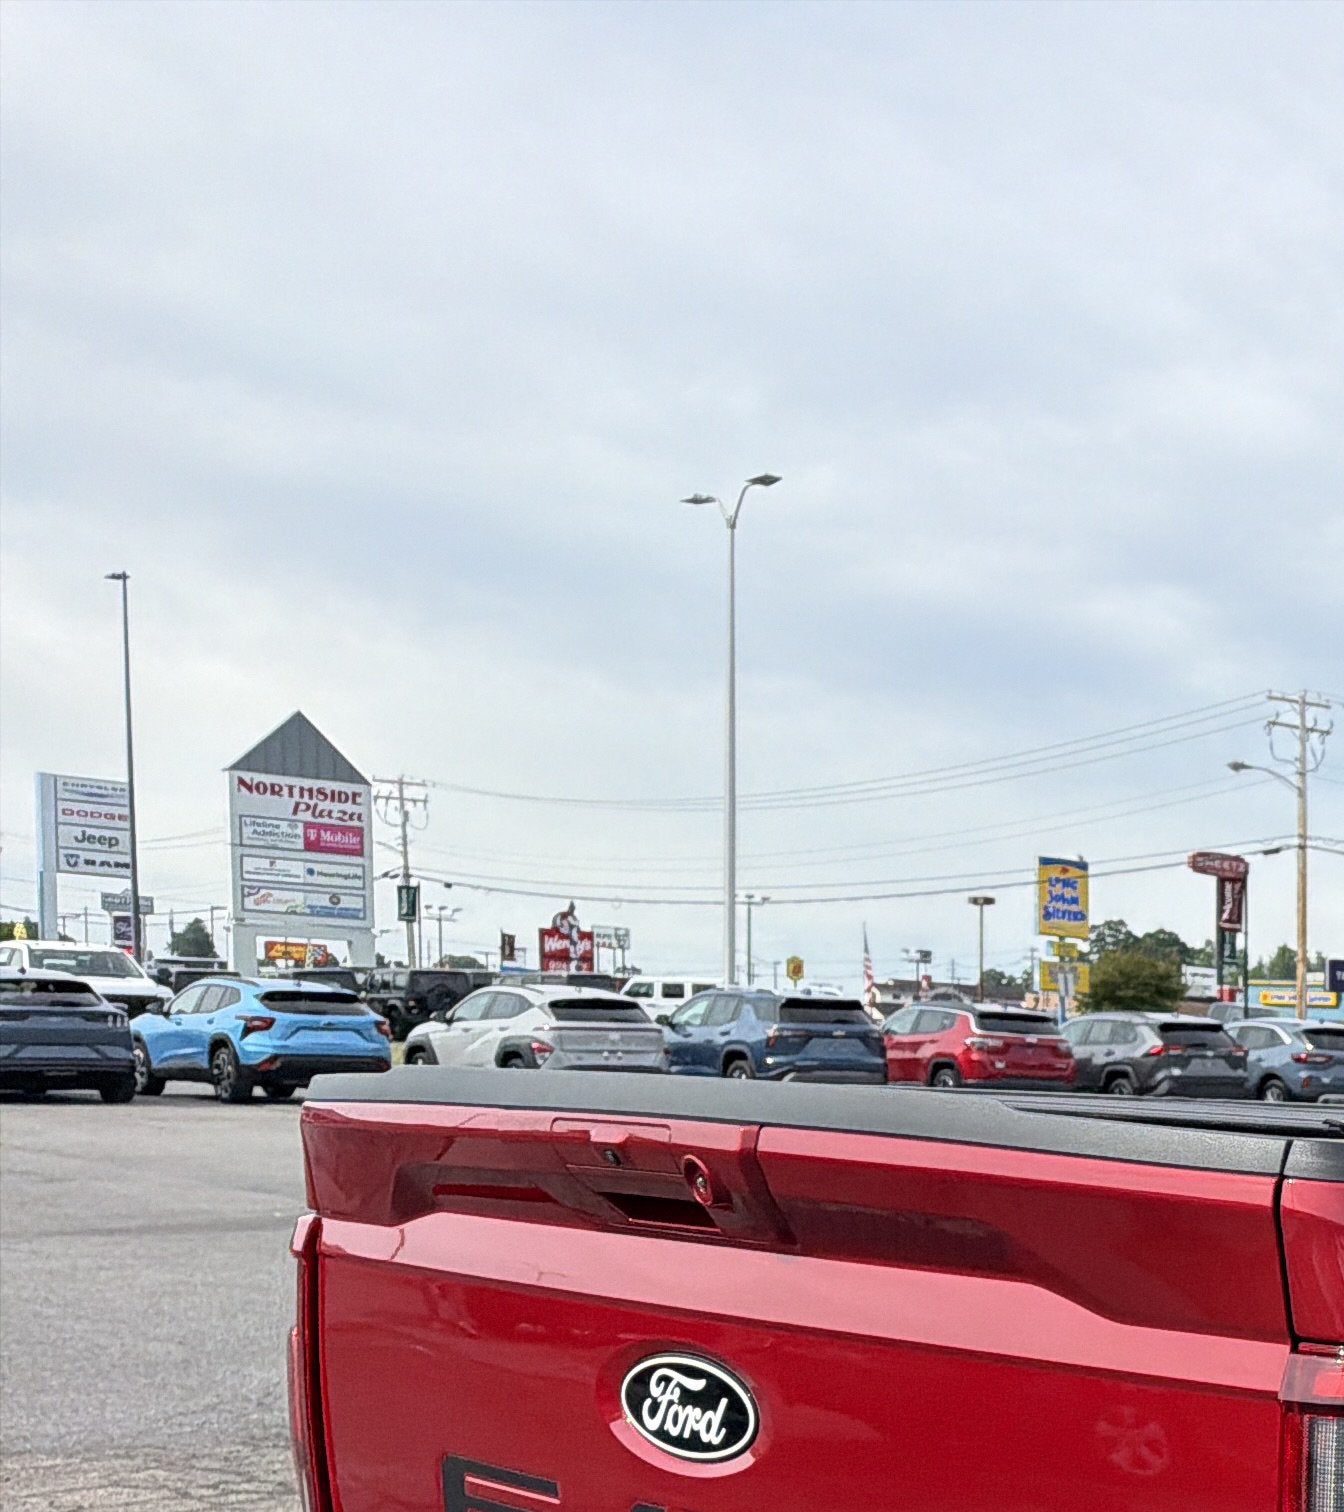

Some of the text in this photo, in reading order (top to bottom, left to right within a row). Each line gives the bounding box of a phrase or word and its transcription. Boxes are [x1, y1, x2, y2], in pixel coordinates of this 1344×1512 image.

[237, 776, 363, 806] NORTHSIDE
[61, 808, 128, 822] DODGE
[291, 801, 363, 822] Plaza
[74, 830, 120, 849] Jeep
[83, 859, 130, 870] RAM
[642, 1367, 729, 1446] Ford
